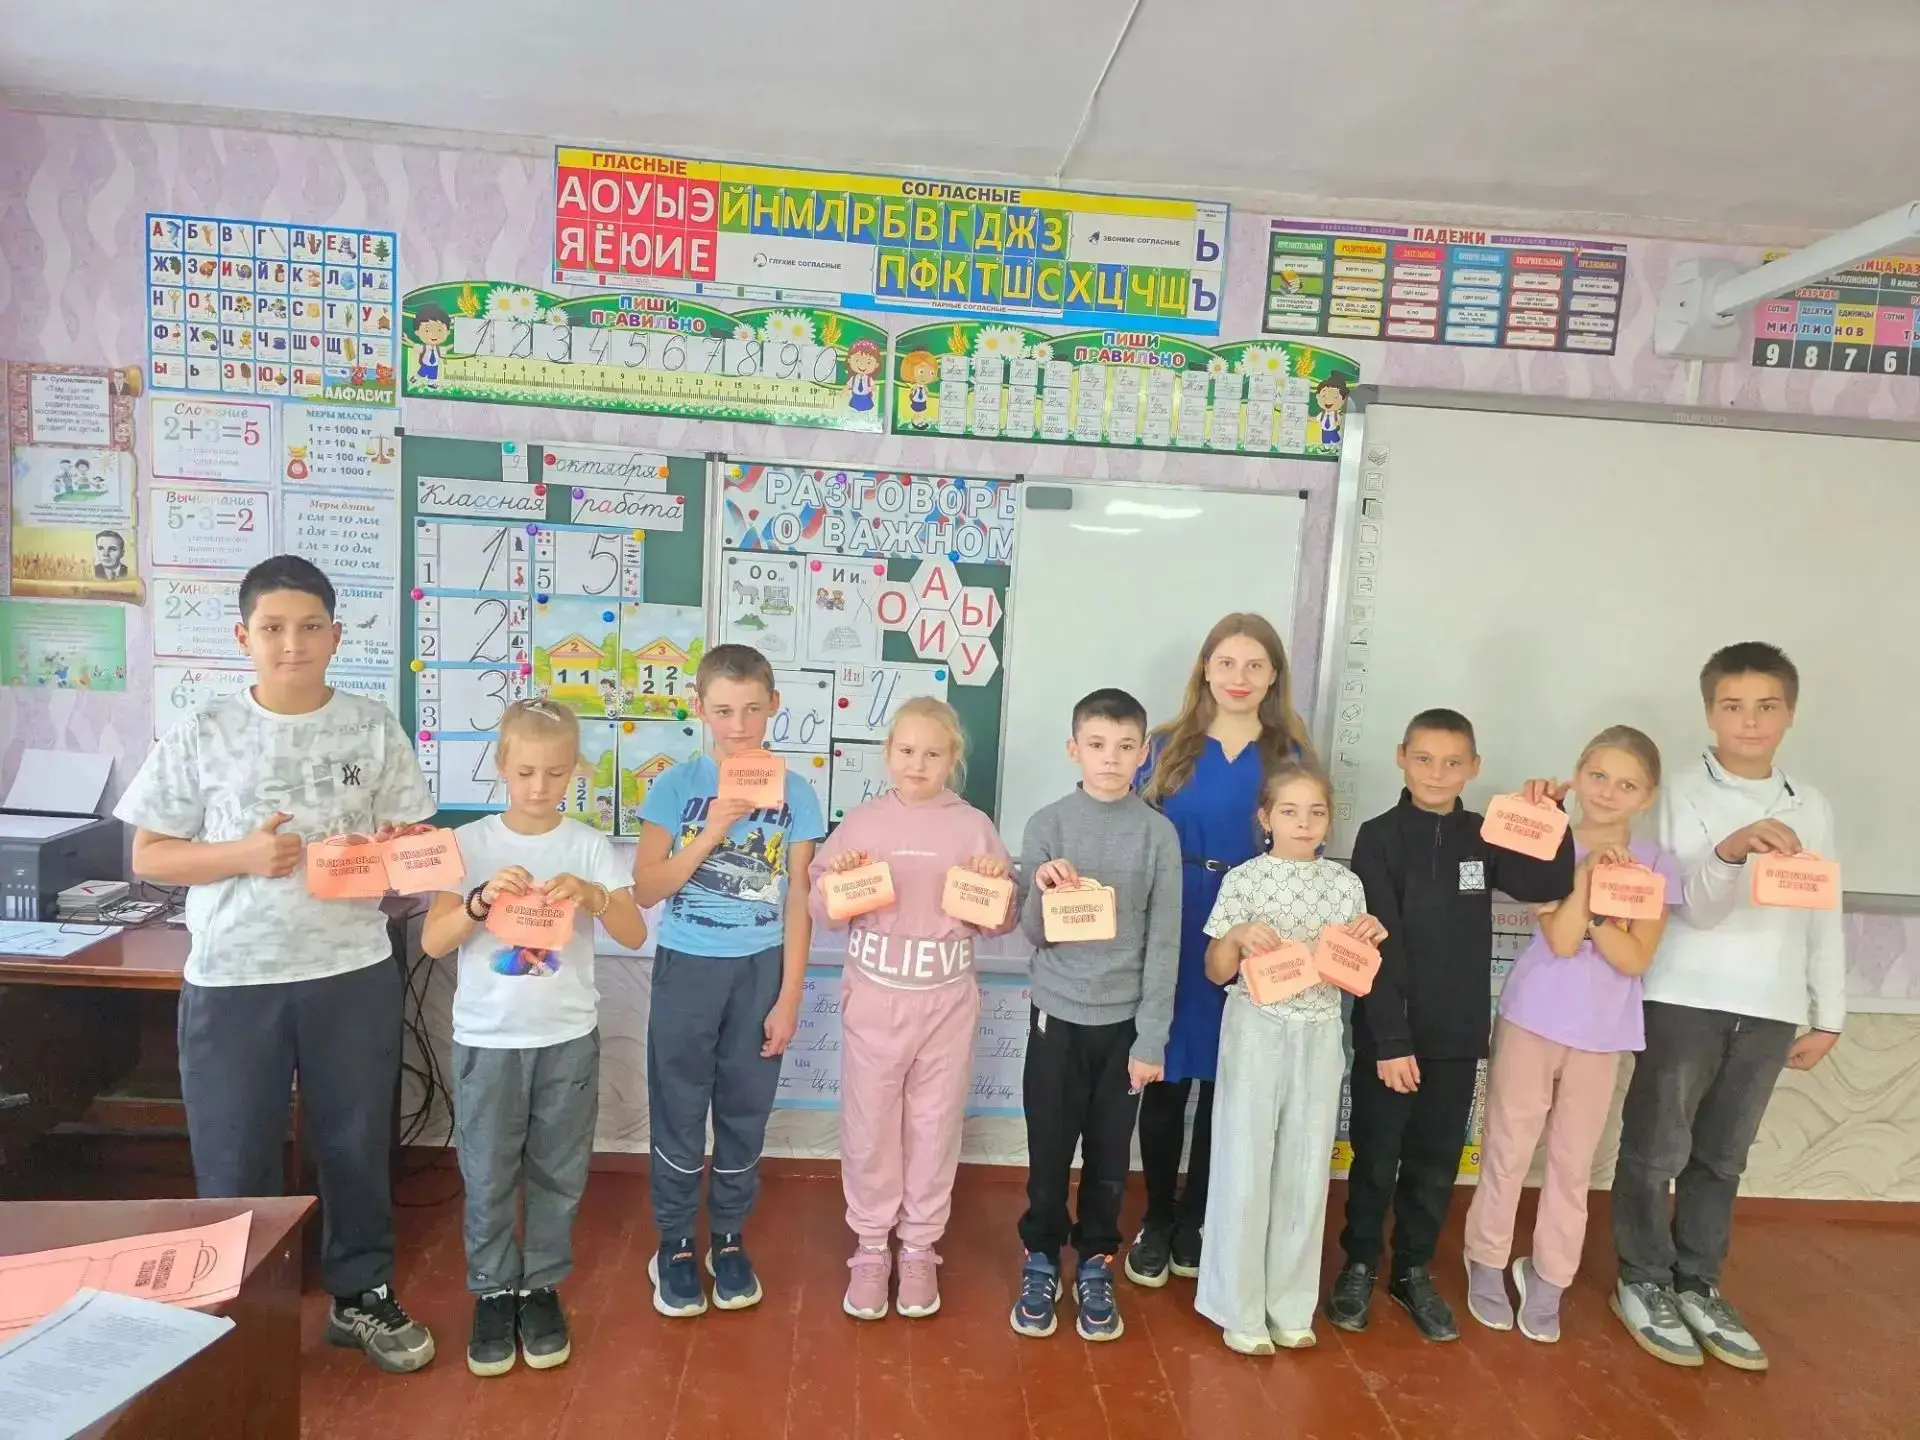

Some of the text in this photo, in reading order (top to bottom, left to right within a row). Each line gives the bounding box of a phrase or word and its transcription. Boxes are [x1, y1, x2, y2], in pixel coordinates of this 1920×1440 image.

[592, 153, 688, 176] ГЛАСНЫЕ
[901, 180, 1021, 204] СОГЛАСНЫЕ
[153, 221, 163, 236] А
[187, 224, 198, 239] Б
[222, 226, 233, 241] В
[257, 229, 266, 244] Г
[293, 230, 305, 248] Д
[327, 235, 336, 250] Е
[1136, 237, 1181, 247] СОГЛАСНЫЕ
[1413, 228, 1486, 245] ПАДЕЖИ
[153, 256, 169, 272] Ж
[187, 258, 198, 273] З
[222, 261, 232, 276] И
[292, 267, 303, 282] К
[326, 270, 339, 285] Л
[362, 272, 373, 288] М
[797, 259, 842, 270] СОГЛАСНЫЕ
[153, 290, 372, 321] Н О П Р С Т У
[619, 294, 679, 314] ПИШИ
[591, 310, 706, 334] ПРАВИЛЬНО
[154, 324, 168, 339] Ф
[189, 326, 200, 342] Х
[222, 329, 234, 346] Ц
[257, 332, 268, 347] Ч
[293, 334, 307, 350] Ш
[326, 337, 341, 354] Щ
[475, 319, 492, 358] 1
[509, 321, 533, 358] 2
[546, 324, 571, 363] 3
[589, 328, 609, 365] 4
[624, 332, 648, 368] 5
[662, 335, 686, 371] 6
[702, 337, 723, 373] 7
[736, 340, 760, 376] 8
[775, 343, 799, 379] 9
[1102, 330, 1160, 349] ПИШИ
[1074, 345, 1186, 368] ПРАВИЛЬНО
[1766, 343, 1897, 373] 9 8 7 6
[223, 364, 235, 379] Э
[258, 366, 273, 382] Ю
[294, 369, 304, 385] Я
[324, 386, 394, 405] АЛФАВИТ
[772, 512, 802, 546] О
[582, 533, 620, 595] 5
[537, 567, 551, 590] 5
[921, 566, 950, 601] А
[961, 593, 994, 628] Ы
[469, 598, 508, 663] 2
[421, 635, 436, 657] 2
[422, 705, 437, 728] 3
[847, 927, 972, 979] BELIEVE
